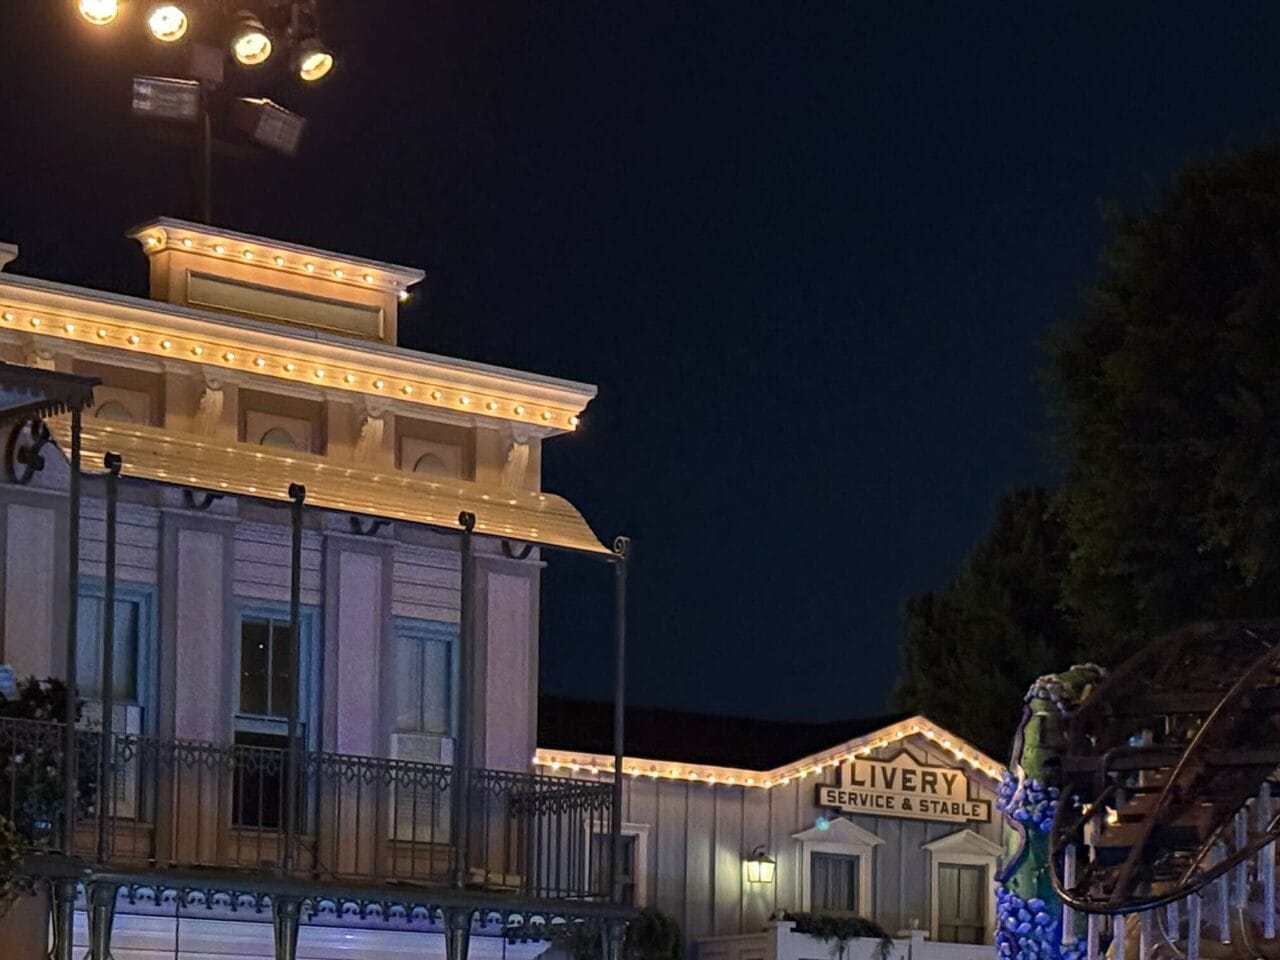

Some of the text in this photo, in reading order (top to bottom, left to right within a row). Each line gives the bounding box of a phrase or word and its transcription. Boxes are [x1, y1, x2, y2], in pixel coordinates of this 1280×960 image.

[850, 764, 958, 796] LIVERY
[827, 789, 981, 817] SERVICE & STABLE
